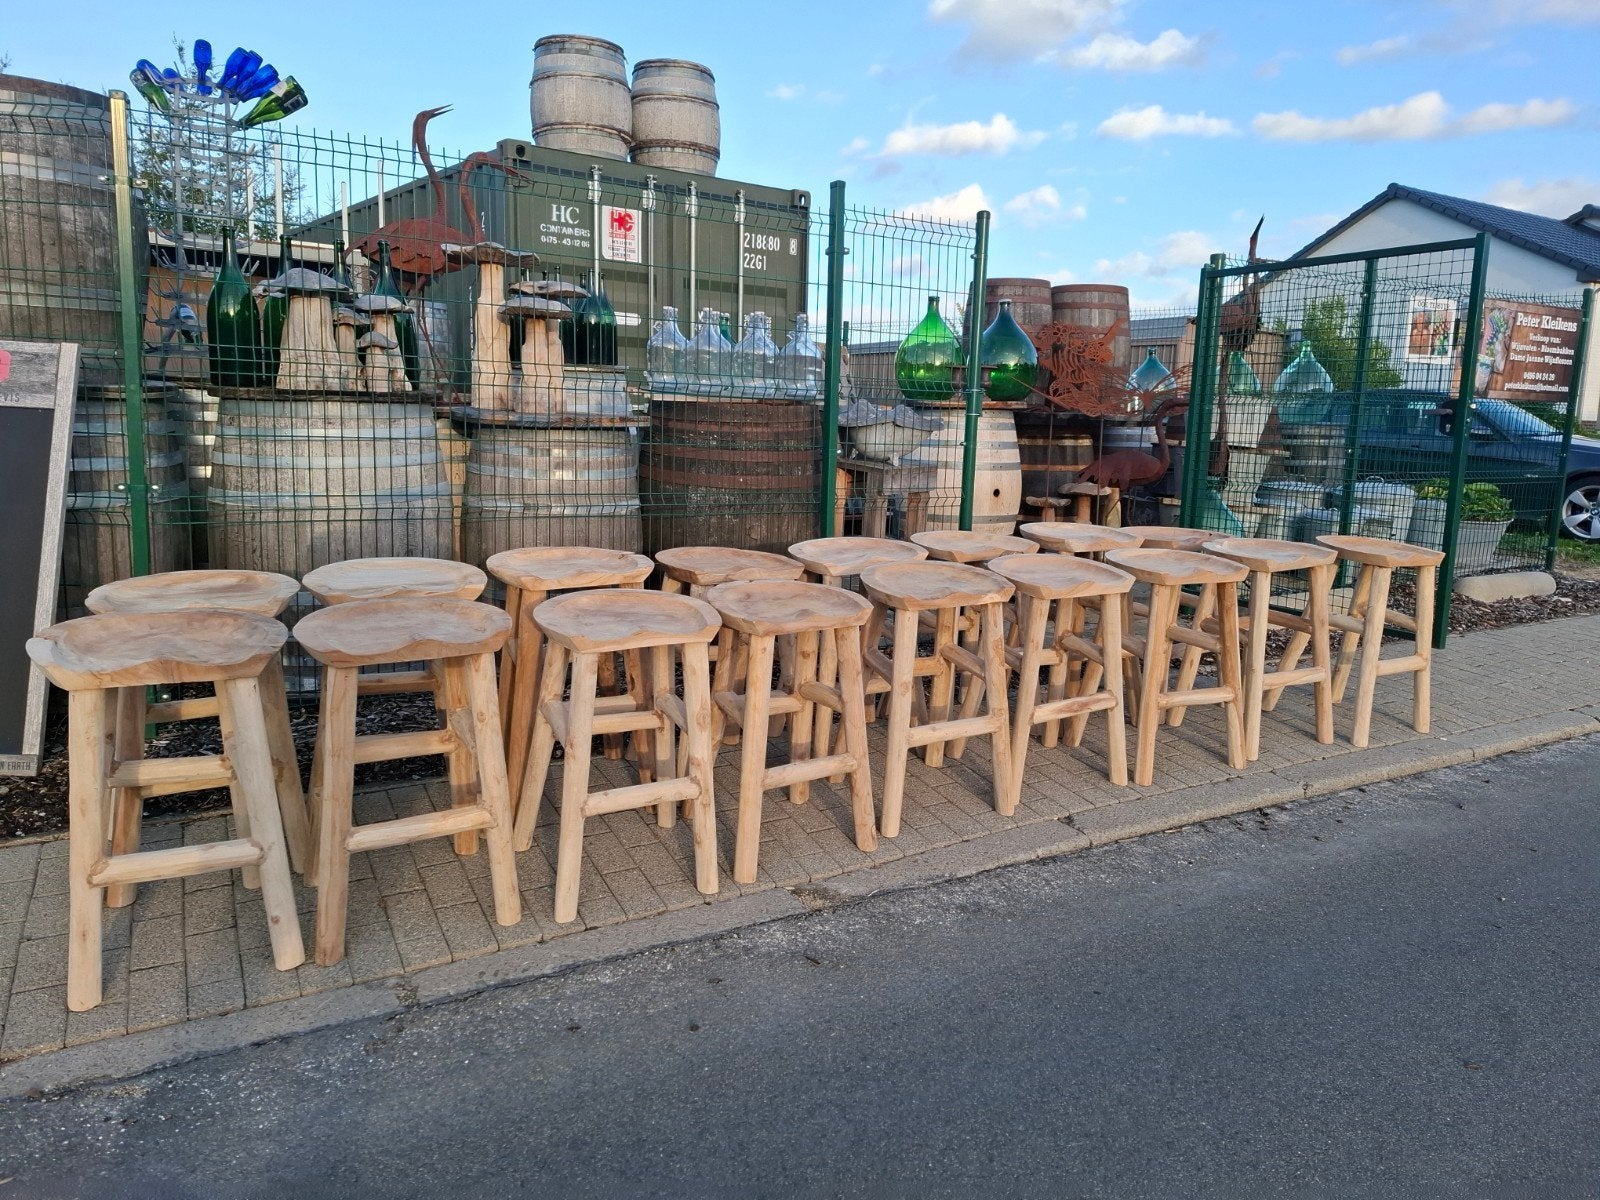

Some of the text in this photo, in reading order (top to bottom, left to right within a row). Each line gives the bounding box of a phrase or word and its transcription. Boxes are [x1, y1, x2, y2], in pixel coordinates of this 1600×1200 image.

[551, 204, 580, 224] HC
[610, 211, 635, 232] HC
[790, 239, 797, 254] 8
[1517, 312, 1577, 331] Peter Kleikens
[8, 761, 30, 770] EARTH
